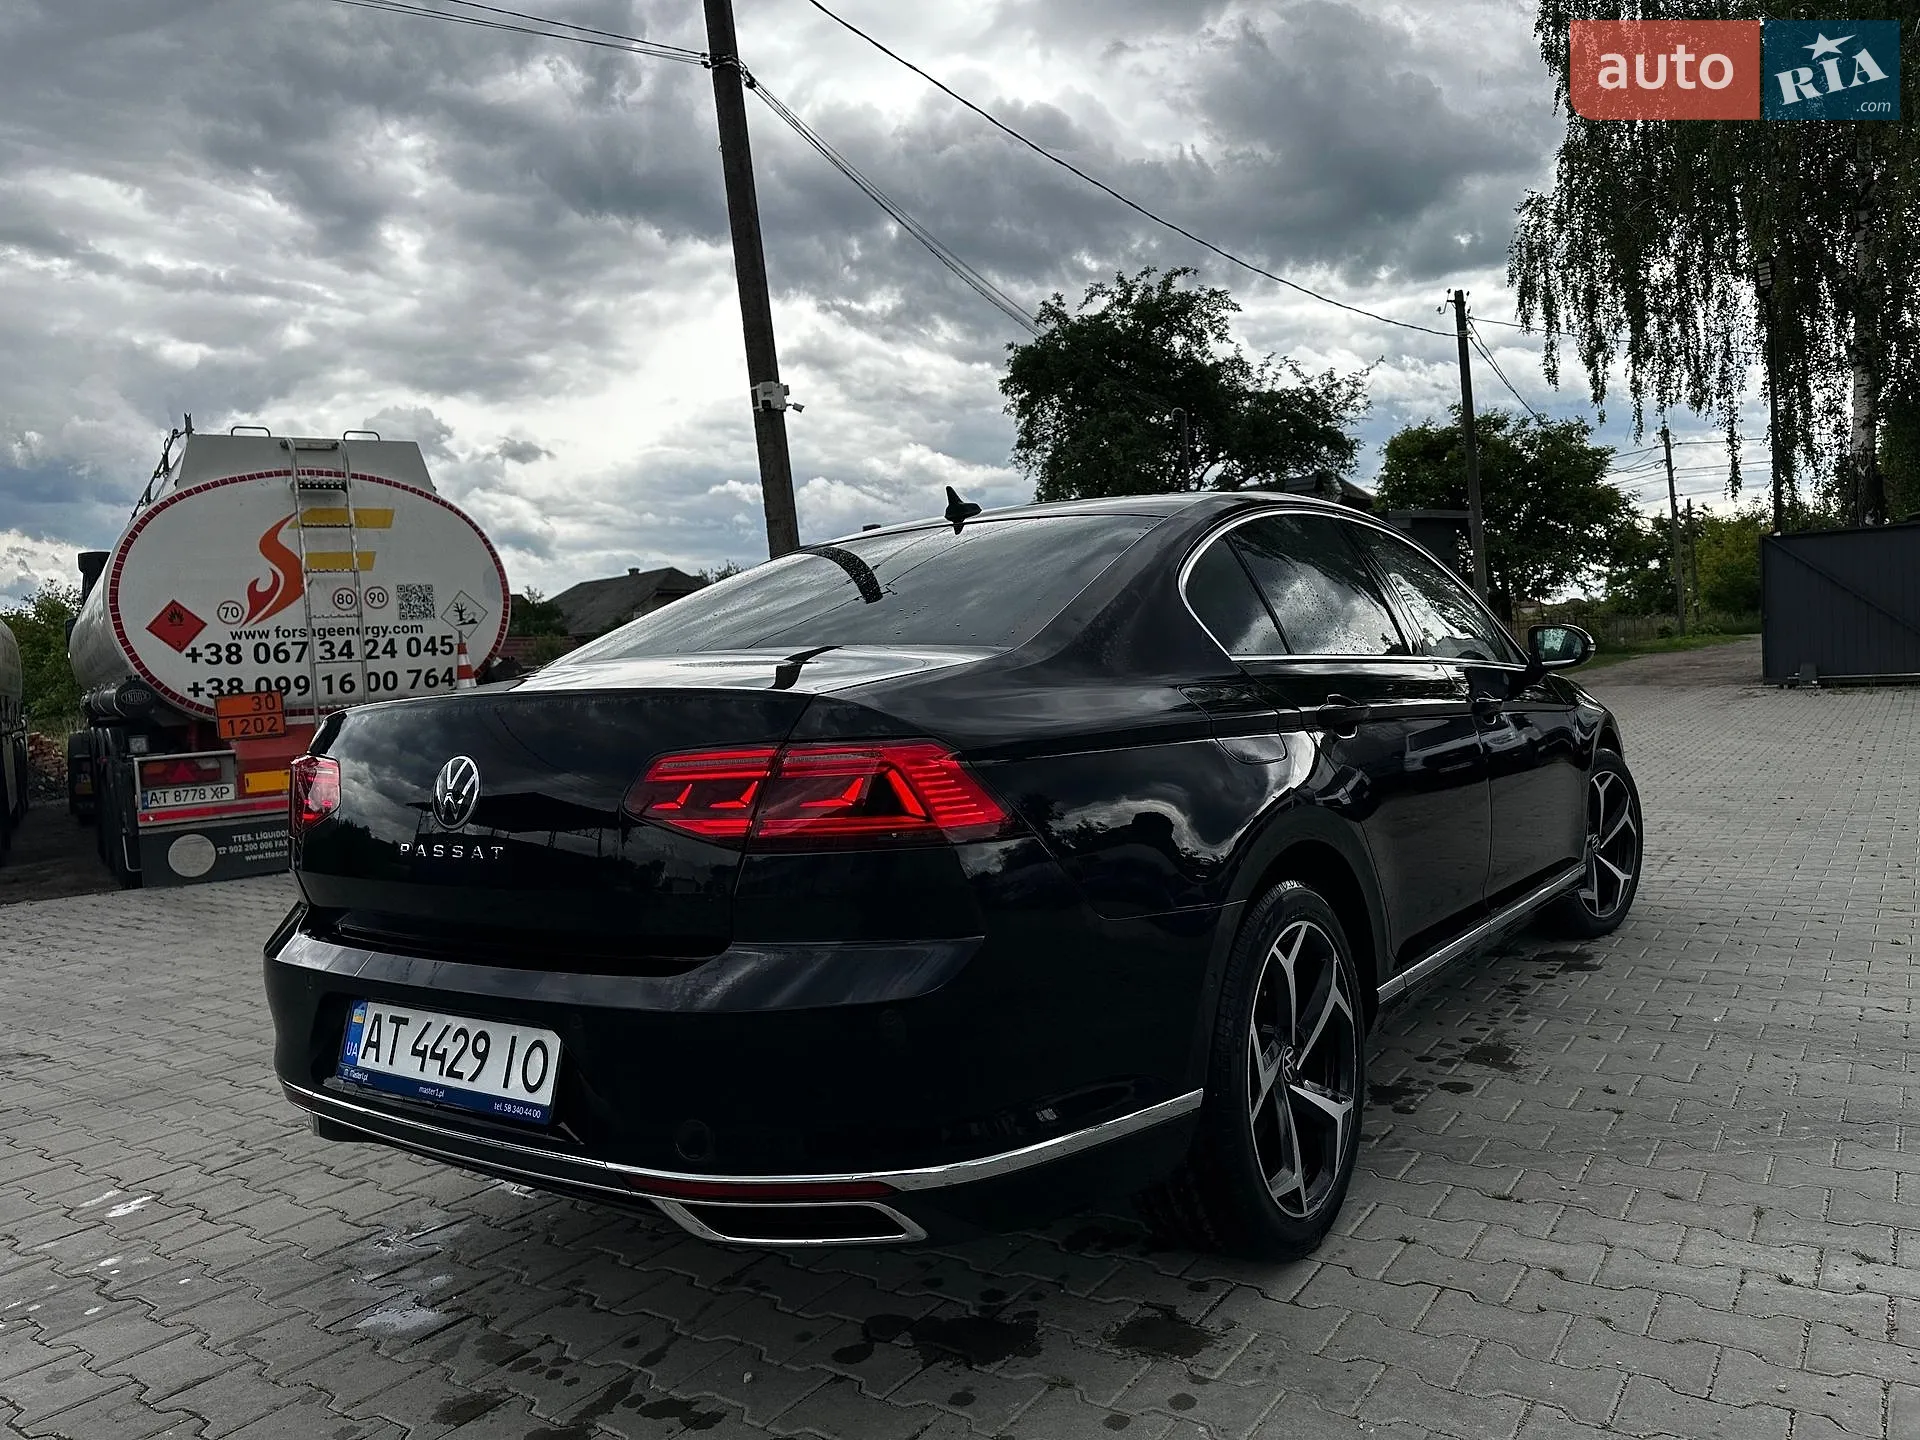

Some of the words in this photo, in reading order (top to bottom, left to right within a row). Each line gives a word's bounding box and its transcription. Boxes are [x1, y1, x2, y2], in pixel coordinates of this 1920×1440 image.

[337, 593, 353, 605] 80
[368, 592, 385, 603] 90
[222, 607, 239, 619] 70
[185, 642, 243, 665] +38
[253, 641, 309, 664] 067
[319, 639, 354, 661] 34
[364, 638, 397, 660] 24
[406, 635, 454, 657] 045
[187, 677, 244, 699] +38
[255, 675, 311, 697] 099
[321, 672, 356, 695] 16
[367, 670, 398, 692] 00
[407, 667, 456, 690] 764
[252, 695, 276, 711] 30
[228, 716, 278, 737] 1202
[150, 791, 170, 805] AT
[174, 788, 206, 802] 8778
[211, 787, 230, 800] XP
[400, 843, 504, 859] PASSAT
[346, 1041, 358, 1057] UA
[361, 1013, 410, 1066] AT
[410, 1021, 491, 1081] 4429
[503, 1103, 512, 1113] 58
[532, 1109, 542, 1119] 00
